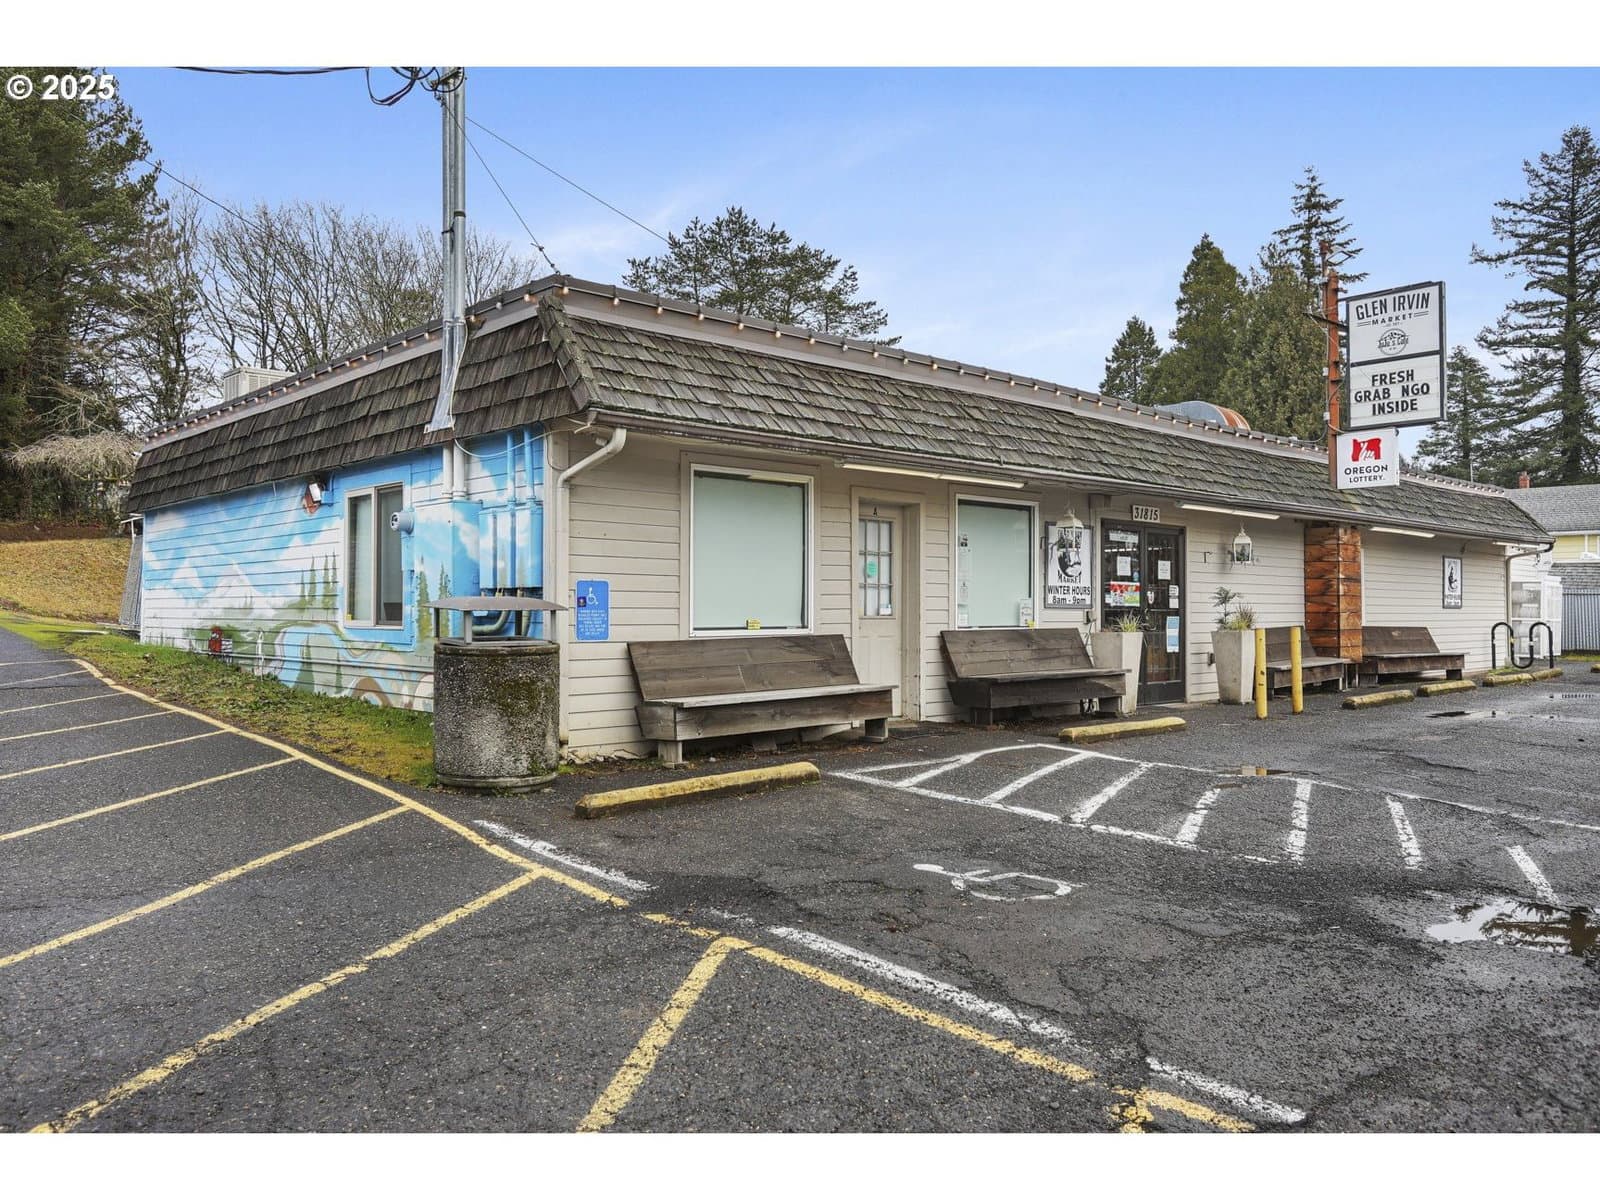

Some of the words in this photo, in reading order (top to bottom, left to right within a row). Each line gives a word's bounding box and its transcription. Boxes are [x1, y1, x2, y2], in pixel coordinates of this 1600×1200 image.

[1356, 298, 1388, 320] GLEN
[1393, 292, 1430, 312] IRVIN
[1372, 313, 1412, 325] MARKET
[1371, 369, 1415, 387] FRESH
[1354, 387, 1391, 404] GRAB
[1401, 382, 1430, 399] NGO
[1372, 398, 1418, 416] INSIDE
[1344, 464, 1388, 475] OREGON
[1134, 507, 1159, 520] 31815
[1048, 585, 1070, 595] WINTER
[1071, 585, 1091, 596] HOURS
[1052, 596, 1067, 604] 8am
[1072, 596, 1086, 605] 9pm
